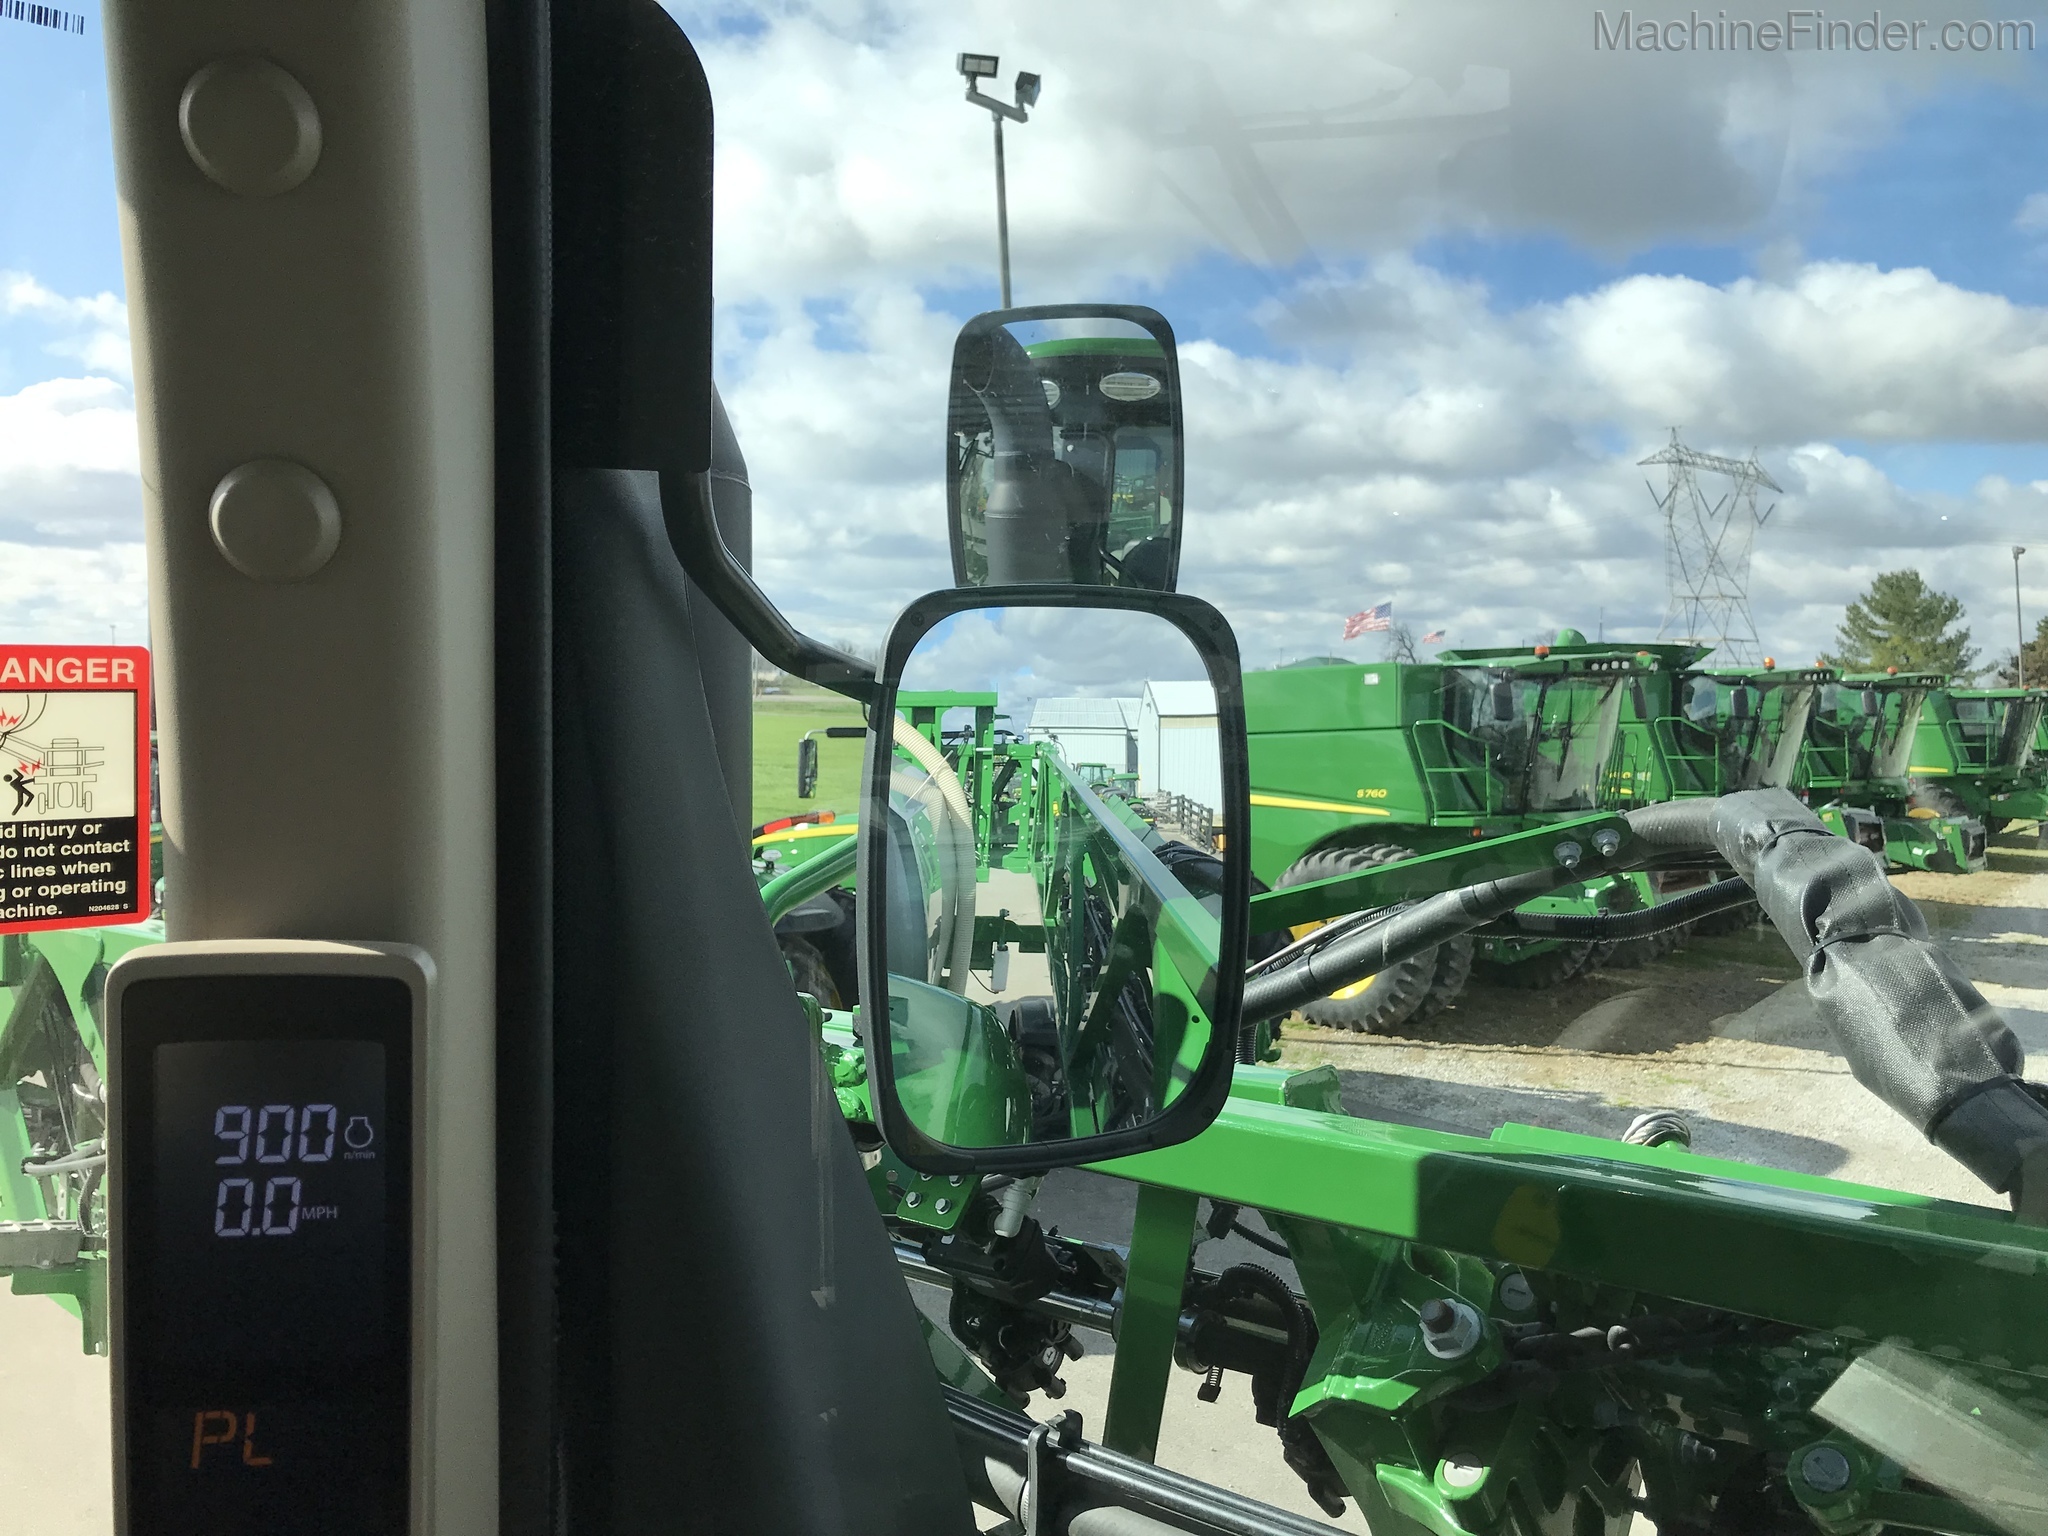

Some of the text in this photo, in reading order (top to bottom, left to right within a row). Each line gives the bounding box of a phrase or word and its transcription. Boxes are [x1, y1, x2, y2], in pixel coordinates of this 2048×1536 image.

[0, 657, 135, 684] ANGER
[22, 823, 77, 840] injury
[82, 823, 103, 835] or
[24, 843, 55, 858] not
[60, 839, 130, 856] contact
[10, 864, 56, 879] lines
[61, 861, 112, 875] when
[11, 886, 32, 898] or
[37, 879, 126, 899] operating
[215, 1104, 337, 1165] 900
[344, 1150, 376, 1160] n/min
[215, 1177, 338, 1237] 0.0 MPH
[190, 1411, 273, 1469] PL
